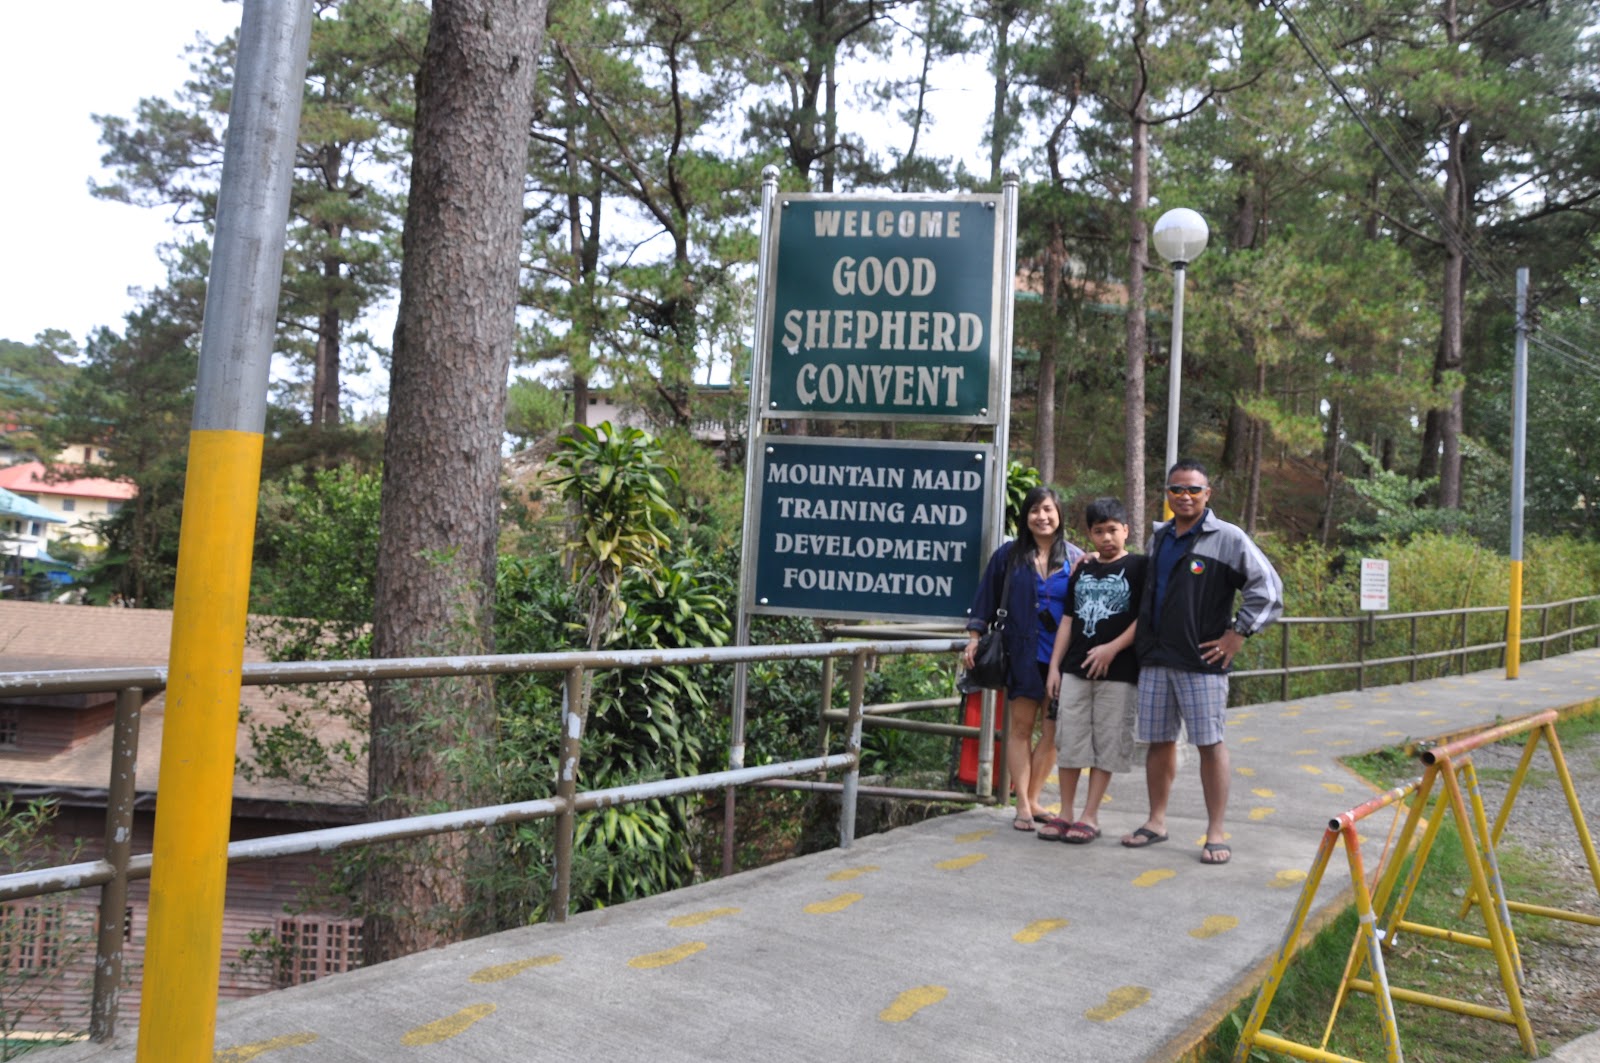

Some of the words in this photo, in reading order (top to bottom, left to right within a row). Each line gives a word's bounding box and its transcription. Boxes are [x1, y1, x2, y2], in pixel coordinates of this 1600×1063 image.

[814, 210, 961, 238] WELCOME
[832, 256, 936, 296] GOOD
[781, 309, 983, 355] SHEPHERD
[796, 363, 964, 406] CONVENT
[767, 463, 904, 488] MOUNTAIN
[912, 469, 981, 491] MAID
[778, 497, 904, 523] TRAINING
[911, 505, 967, 526] AND
[774, 533, 966, 562] DEVELOPMENT
[783, 568, 953, 597] FOUNDATION
